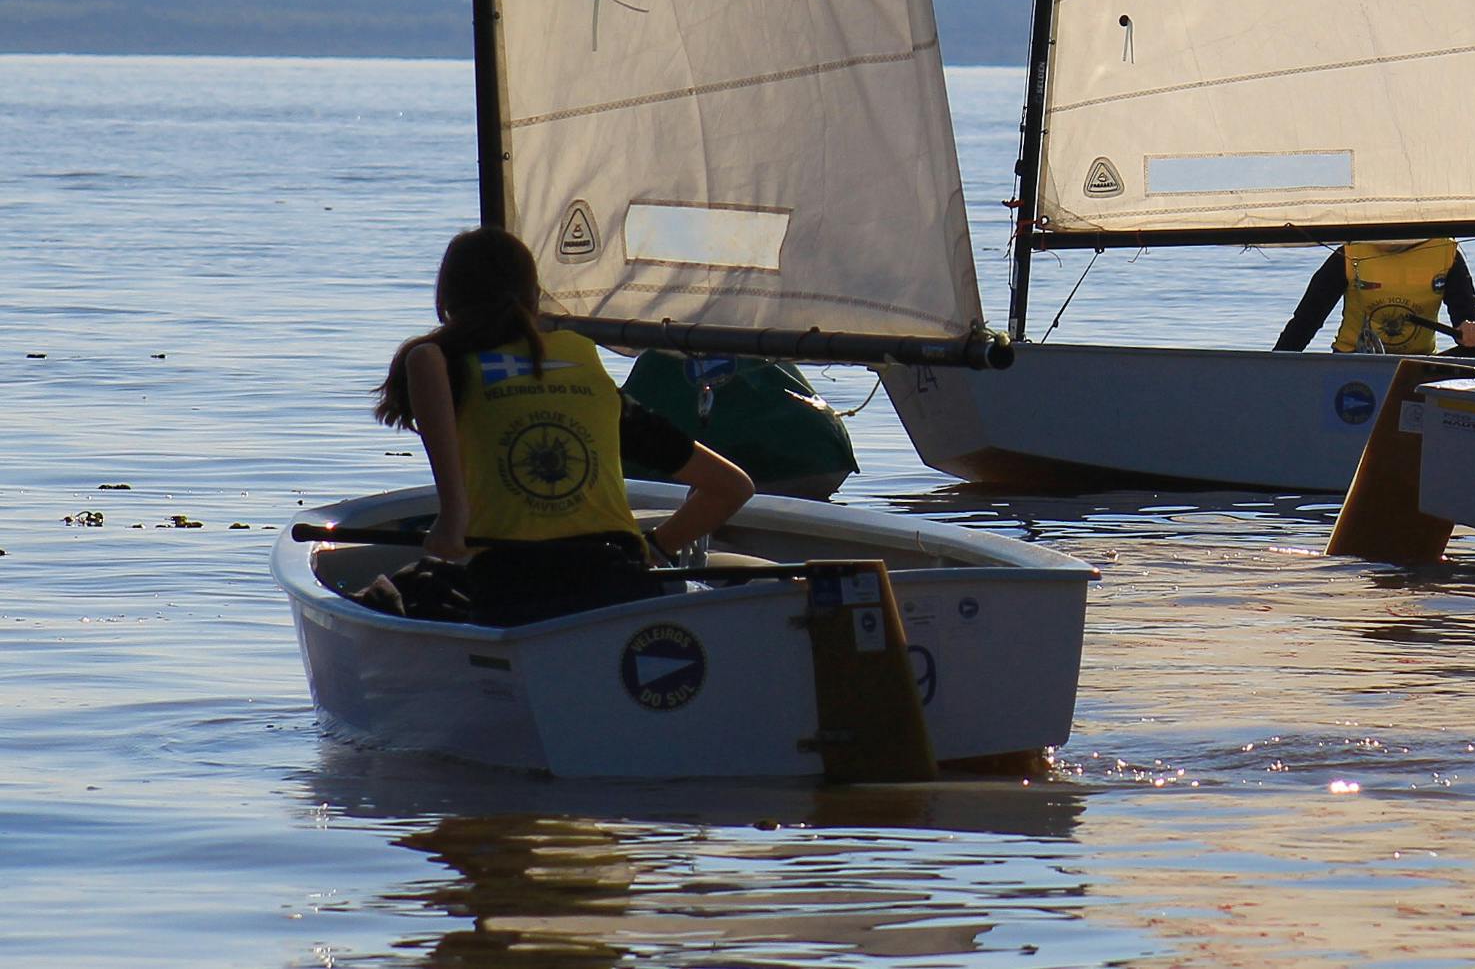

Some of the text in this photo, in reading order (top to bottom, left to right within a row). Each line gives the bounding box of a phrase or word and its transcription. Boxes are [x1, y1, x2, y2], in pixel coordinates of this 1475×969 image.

[630, 627, 693, 652] VELEIROS
[640, 683, 696, 708] DO SUL
